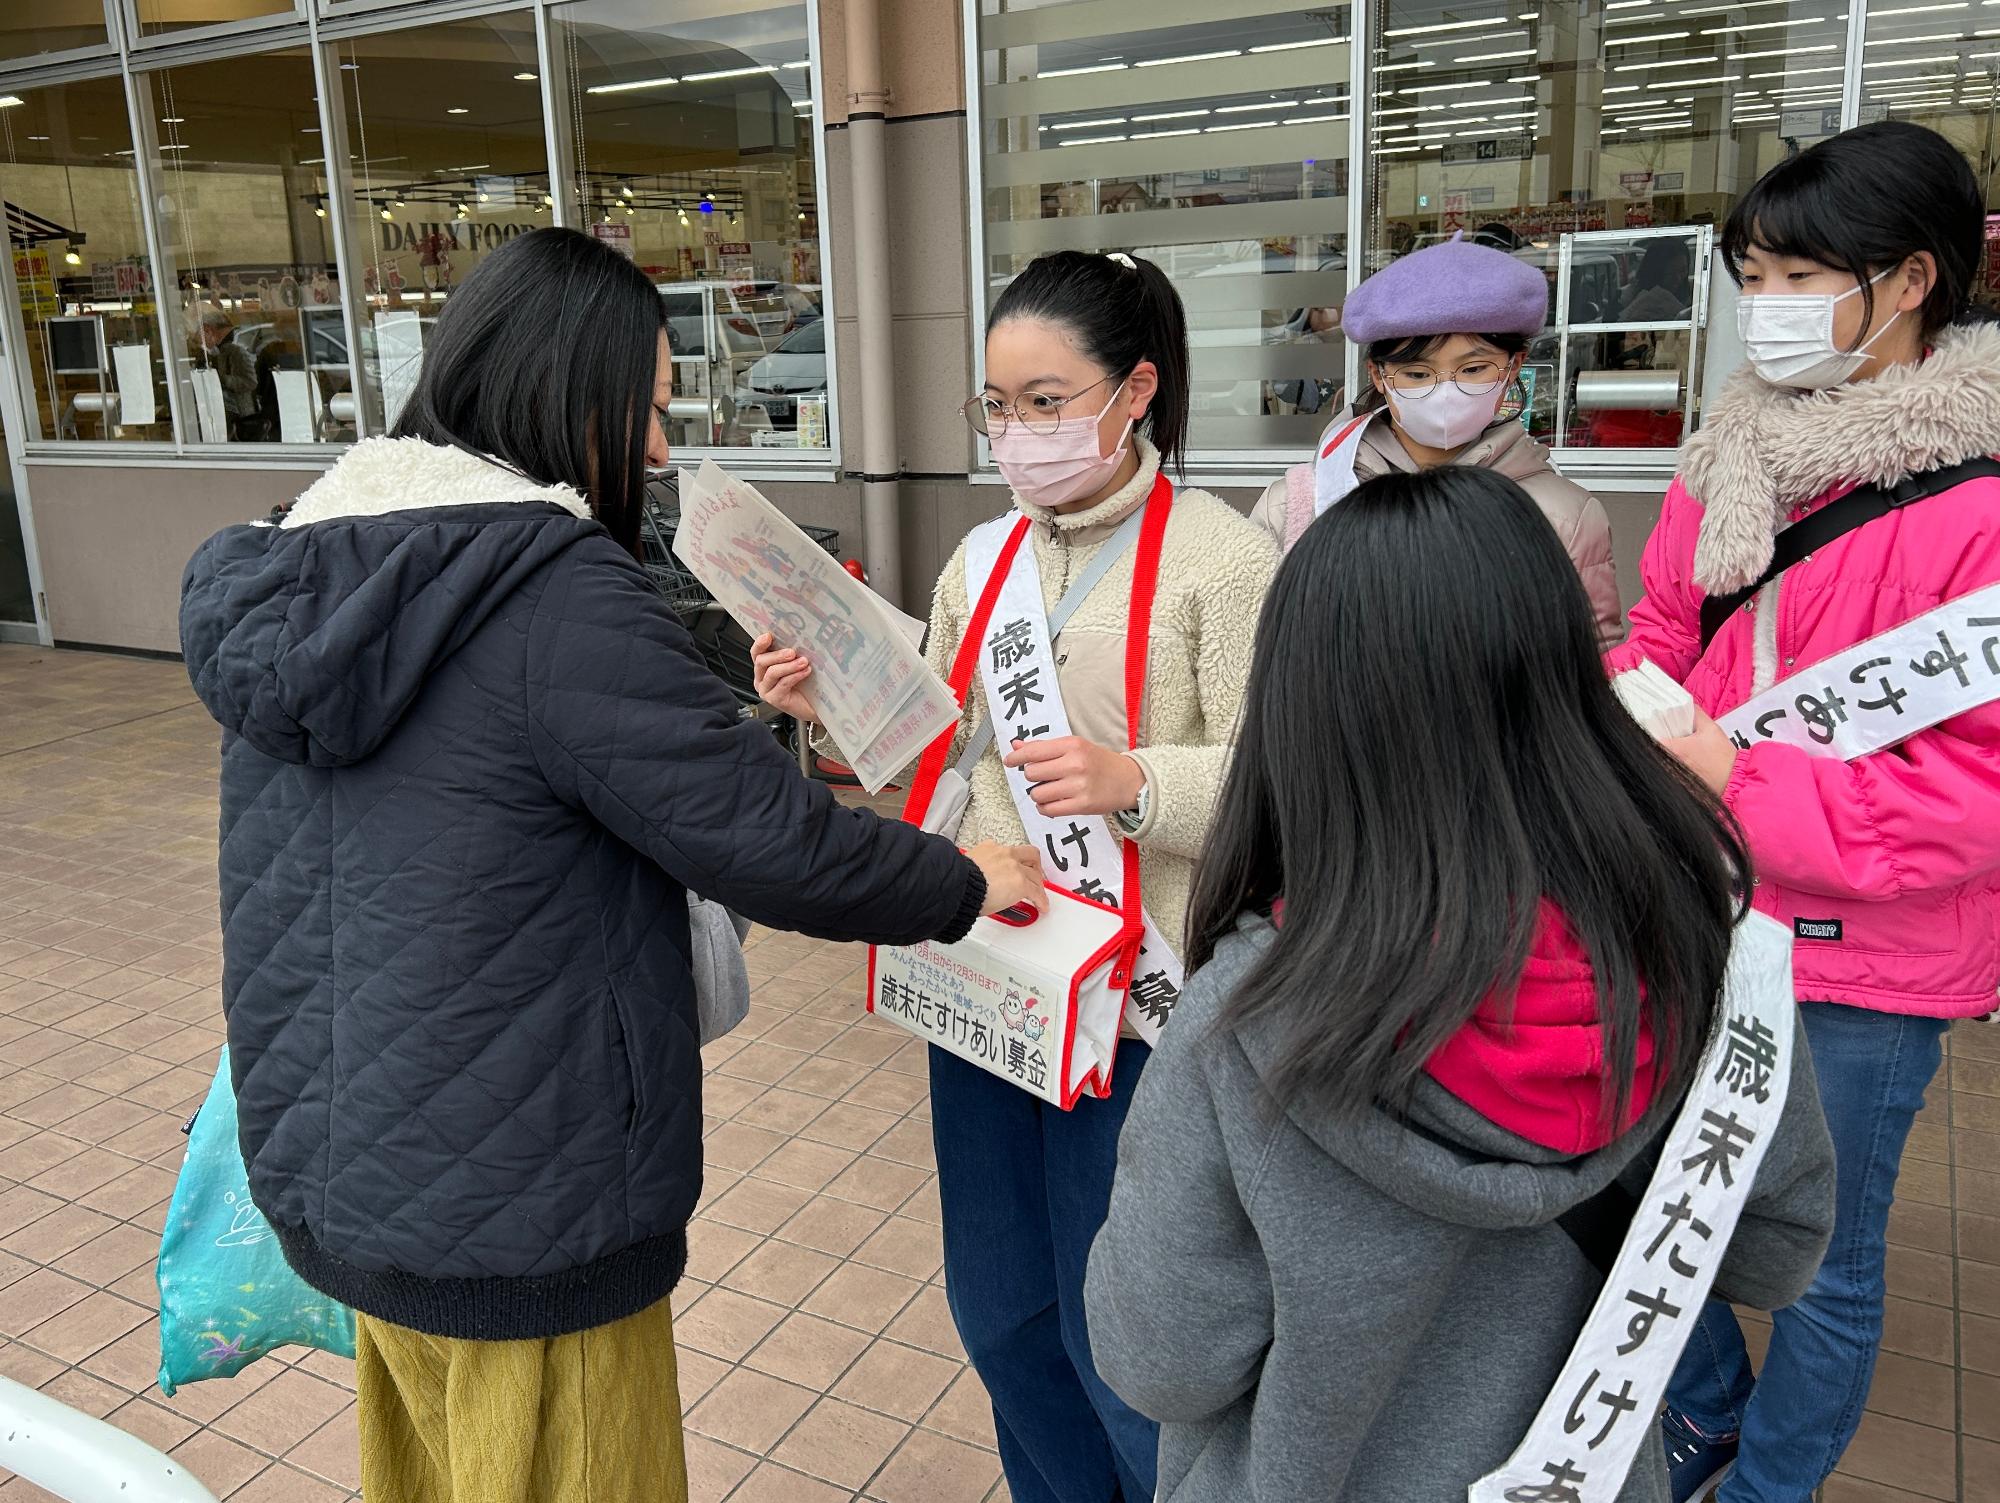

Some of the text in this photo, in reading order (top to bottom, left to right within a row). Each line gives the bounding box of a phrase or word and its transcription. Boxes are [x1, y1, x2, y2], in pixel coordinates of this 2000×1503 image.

[1478, 143, 1495, 157] 14
[380, 221, 459, 252] DAILY
[706, 231, 721, 245] 104
[1799, 922, 1837, 937] WHAT?
[889, 947, 965, 993] みんなでささえあう
[908, 968, 997, 1023] あったかい地域づくり
[880, 973, 1047, 1091] 歳末たすけあい募金
